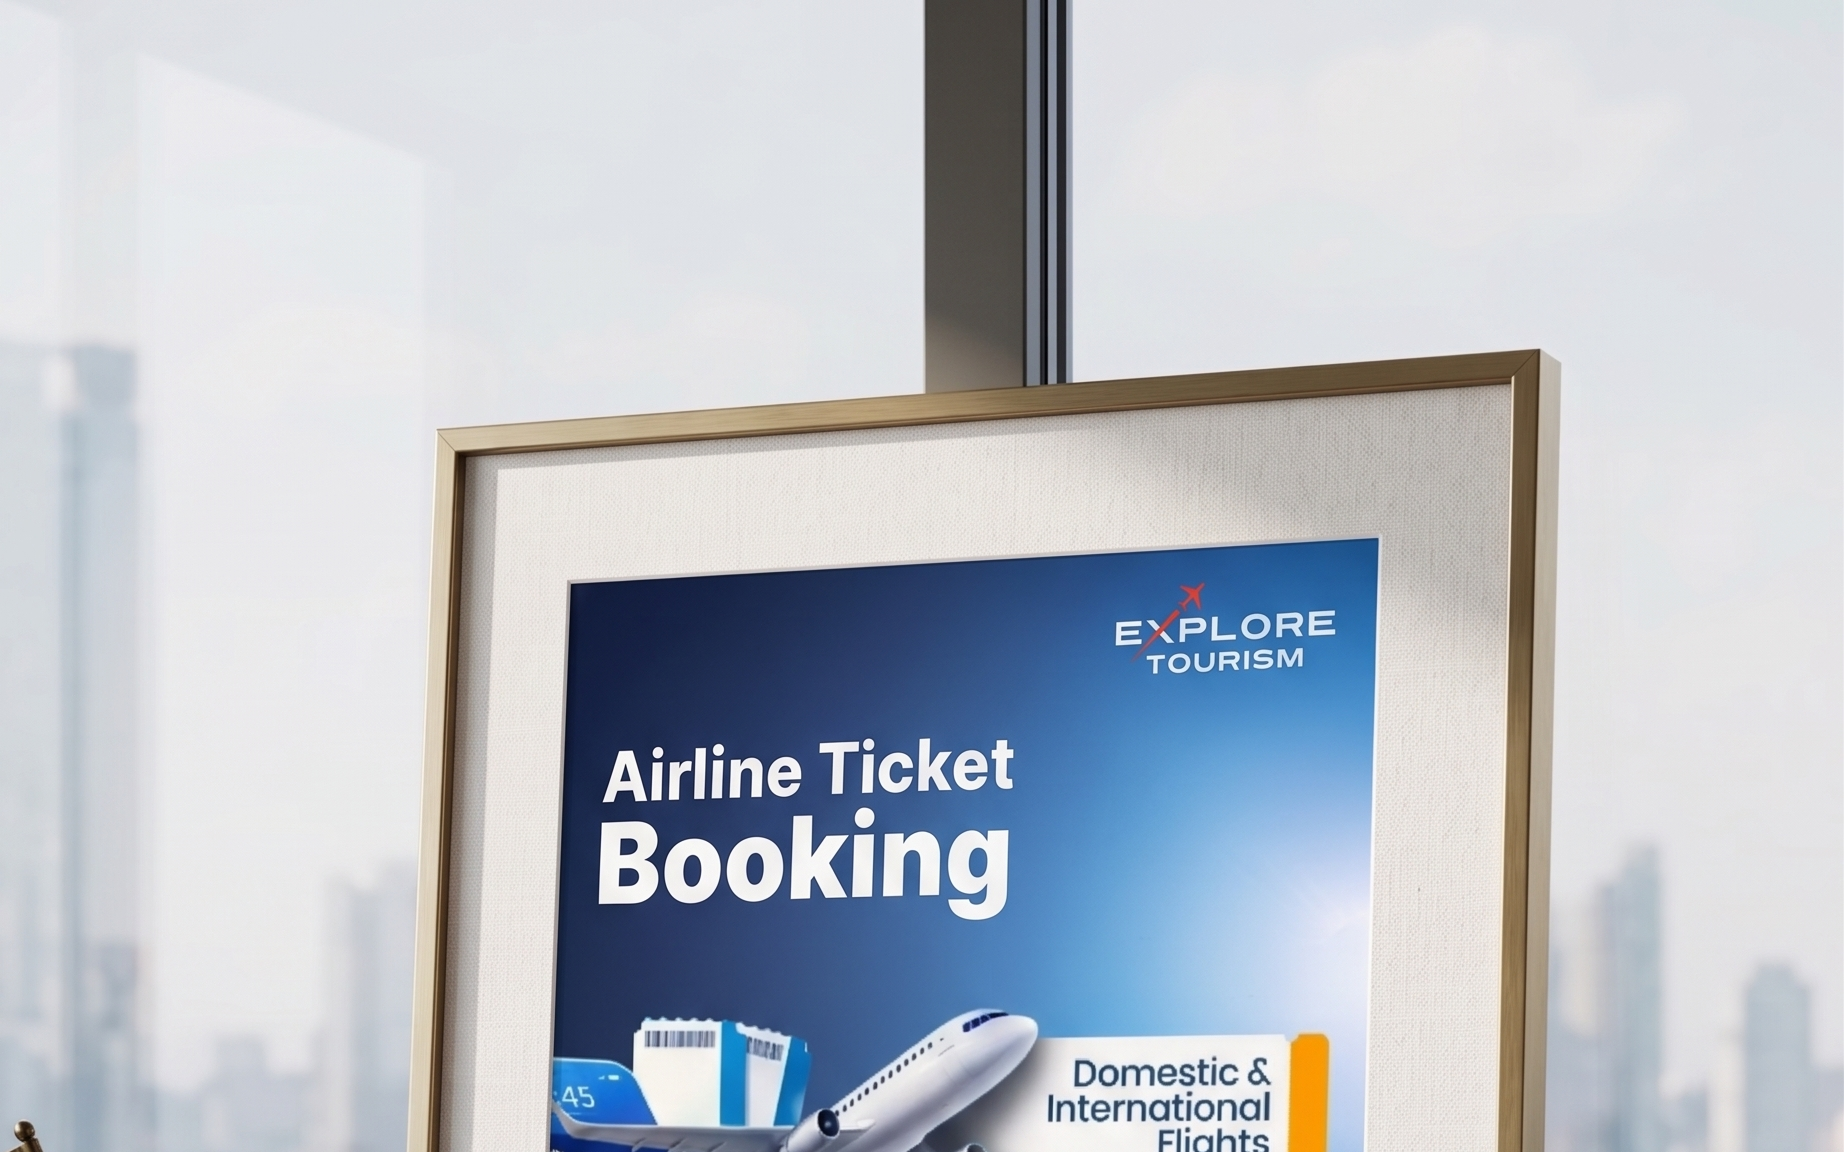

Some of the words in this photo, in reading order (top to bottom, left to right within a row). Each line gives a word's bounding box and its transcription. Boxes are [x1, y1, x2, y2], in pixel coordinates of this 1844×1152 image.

[1115, 610, 1336, 646] EXPLORE
[1146, 648, 1304, 674] TOURISM
[602, 743, 802, 803] Airline
[819, 738, 1014, 795] Ticket
[598, 807, 1009, 920] Booking
[1073, 1056, 1239, 1087] Domestic
[1247, 1057, 1271, 1086] &
[1047, 1091, 1271, 1122] International
